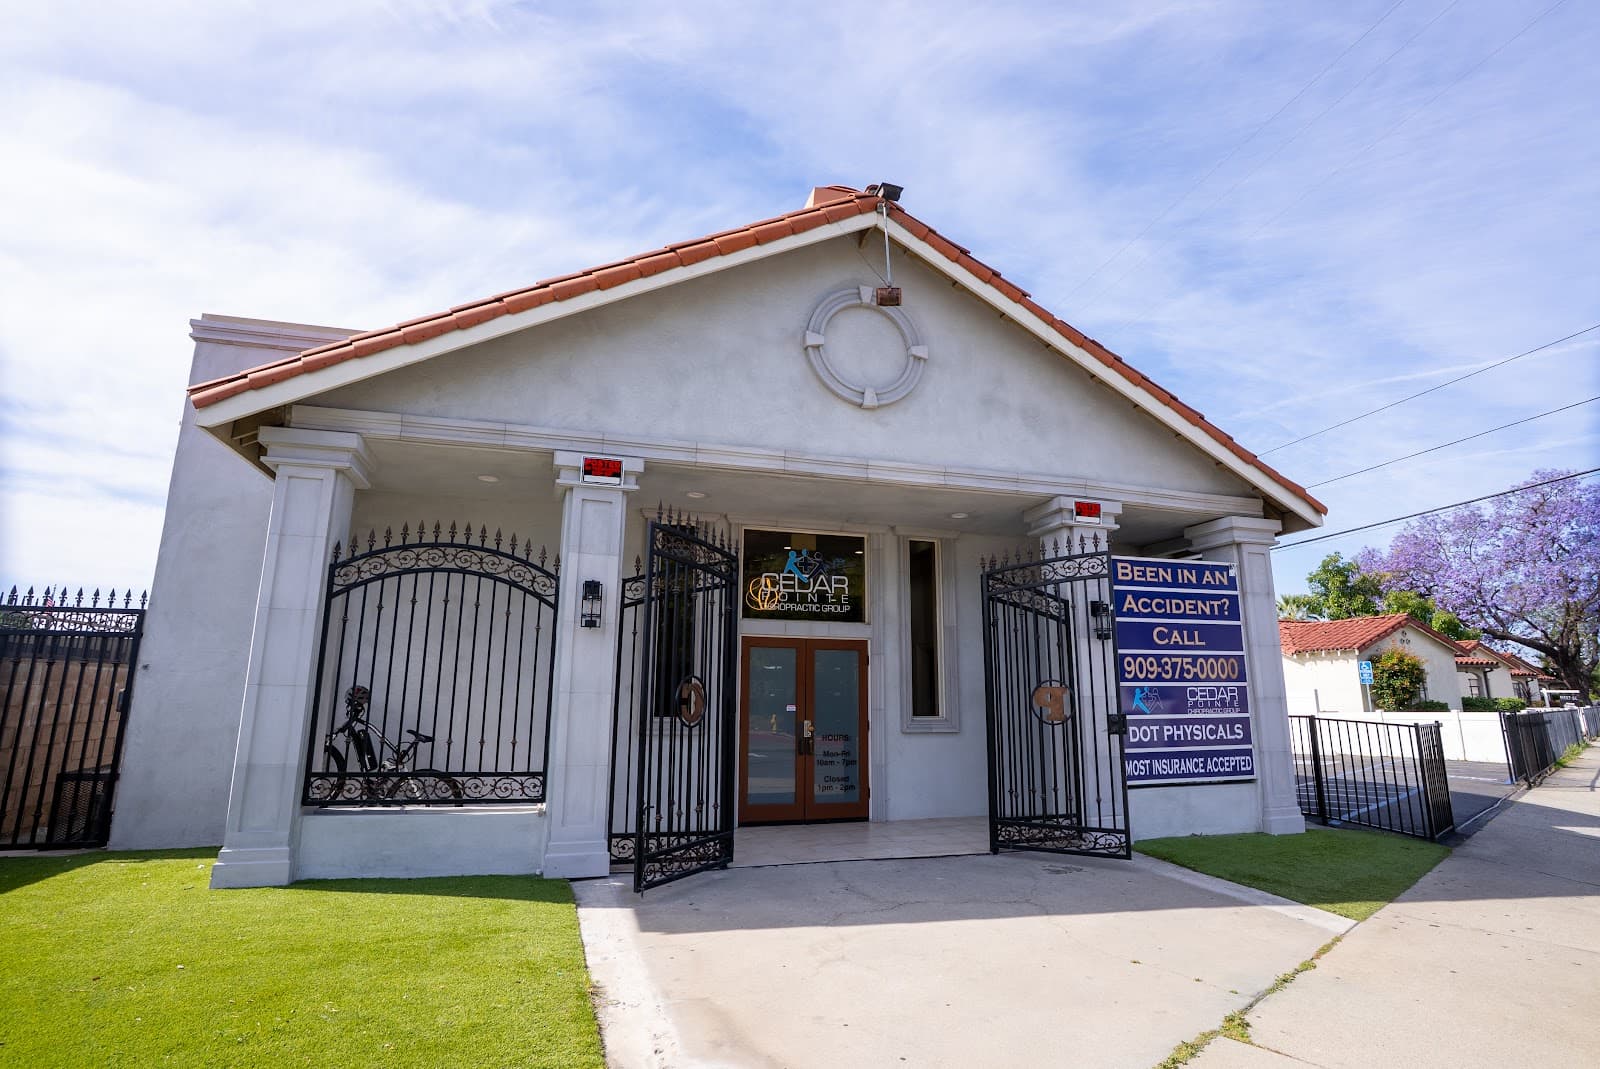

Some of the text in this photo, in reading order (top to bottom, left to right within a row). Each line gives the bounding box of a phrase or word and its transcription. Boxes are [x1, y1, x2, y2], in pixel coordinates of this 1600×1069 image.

[761, 572, 849, 594] CEDAR
[1116, 562, 1229, 586] BEEN IN AN
[821, 604, 851, 613] GROUP
[1122, 594, 1230, 616] ACCIDENT?
[1152, 626, 1206, 646] CALL
[1123, 656, 1239, 680] 909-375-0000
[1186, 687, 1238, 701] CEDAR
[1187, 700, 1240, 708] POINTE
[1129, 723, 1243, 743] DOT PHYSICALS
[1125, 755, 1252, 777] MOST INSURANCE ACCEPTED
[823, 775, 850, 783] Closed
